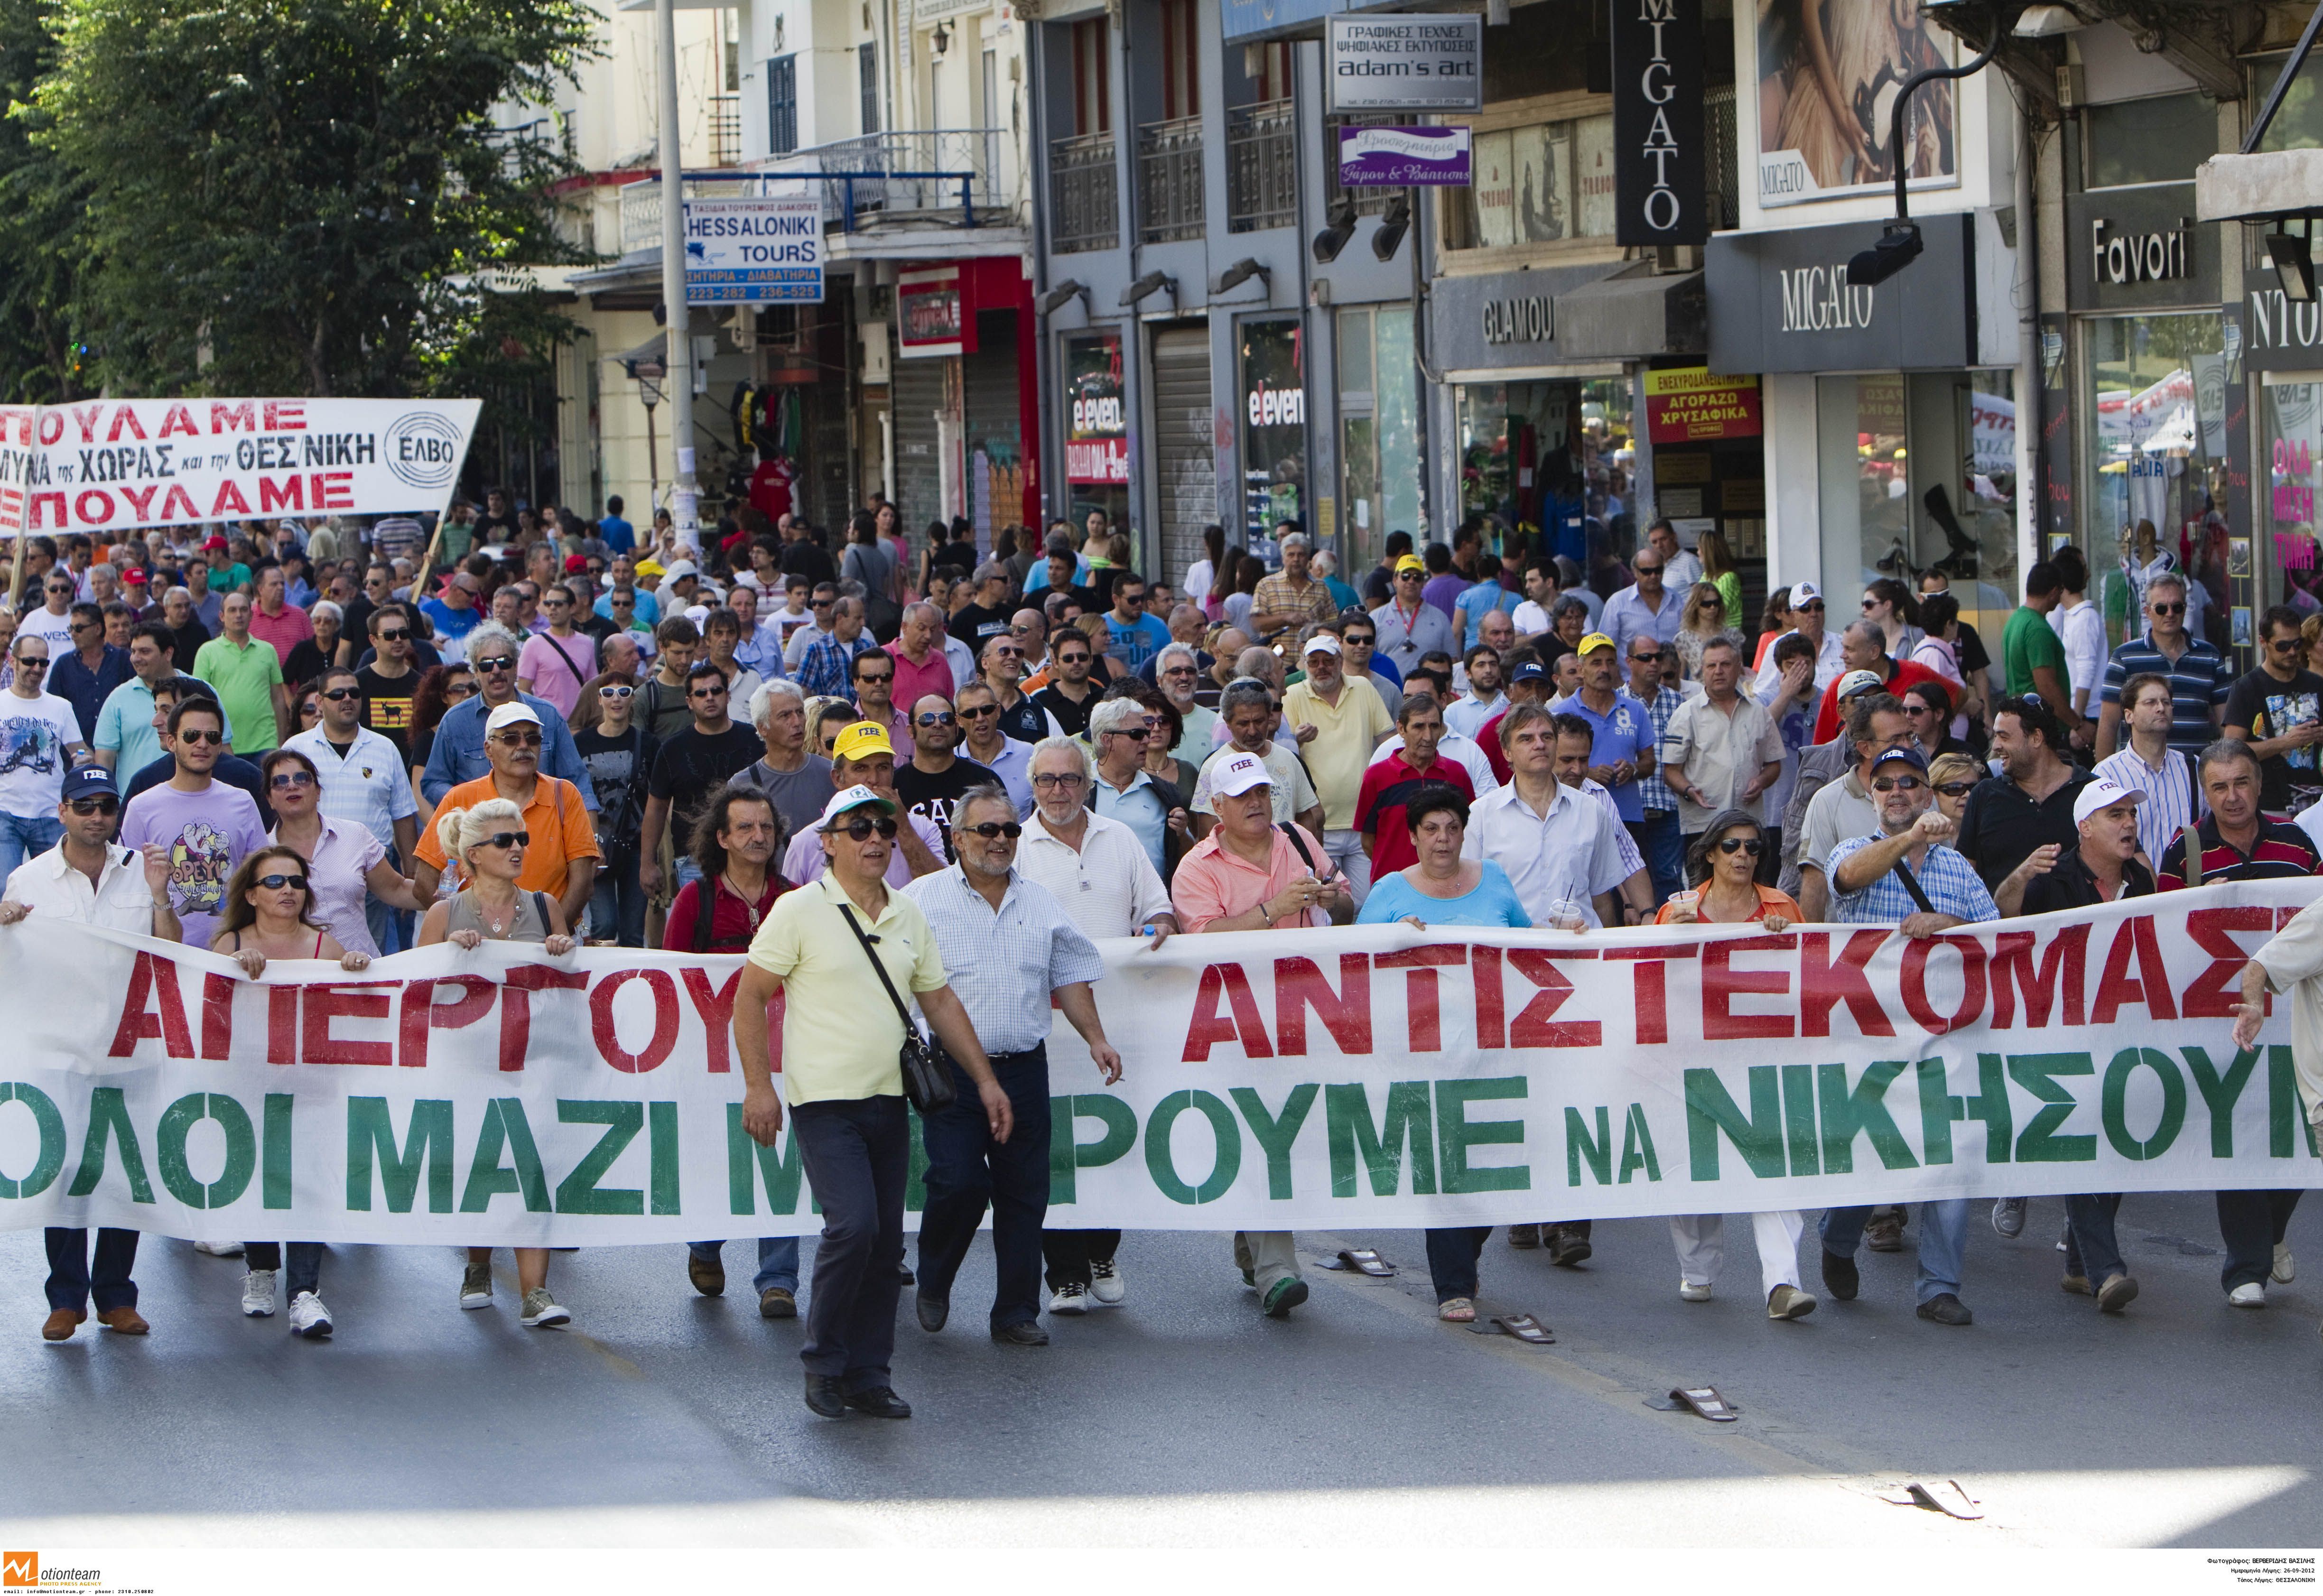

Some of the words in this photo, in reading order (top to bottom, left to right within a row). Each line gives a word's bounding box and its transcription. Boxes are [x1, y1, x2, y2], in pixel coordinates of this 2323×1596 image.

[1348, 26, 1412, 38] ΓΡΑΦΙΚΕΣ
[1419, 26, 1464, 38] ΤΕΧΝΕΣ
[1337, 40, 1402, 52] ΨΗΦΙΑΚΕΣ
[1405, 40, 1477, 52] ΕΚΤΥΠΩΣΕΙΣ
[1338, 60, 1429, 76] adam's
[1438, 60, 1474, 76] art
[1762, 161, 1803, 195] MIGATO
[739, 240, 816, 262] TOURS
[2092, 217, 2185, 284] Favori
[747, 269, 817, 281] ΔΙΑΒΑΤΗΡΙΑ
[759, 286, 815, 297] 236-525
[1780, 264, 1873, 332] MIGATO
[1073, 389, 1120, 432] eleven
[1249, 379, 1304, 426] eleven
[1669, 392, 1738, 409] ΑΓΟΡΑΖΩ
[0, 399, 307, 446] ΠΟΥΛΑΜΕ
[1661, 407, 1747, 425] ΧΡΥΣΑΦΙΚΑ
[58, 464, 74, 483] της
[78, 444, 175, 483] ΧΩΡΑΣ
[181, 455, 202, 471] και
[211, 453, 230, 472] την
[399, 436, 454, 464] ΕΛΒΟ
[2273, 437, 2312, 476] ΟΛΑ
[2274, 485, 2314, 522] ΜΙΣΗ
[2274, 532, 2314, 570] ΤΙΜΗ
[1616, 708, 1631, 728] 8
[858, 727, 881, 736] ΓΣΕΕ
[1614, 727, 1634, 737] STR
[83, 769, 108, 780] ΓΣΕΕ
[1230, 759, 1254, 773] ΓΣΕΕ
[108, 950, 783, 1074] ΑΠΕΡΓΟΥ
[1182, 905, 2306, 1063] ΑΝΤΙΣΤΕΚΟΜΑΣ
[347, 1094, 681, 1216] ΜΑΖΙ
[727, 1076, 1531, 1215] ΜΡΟΥΜΕ
[1566, 1102, 1662, 1188] ΝΑ
